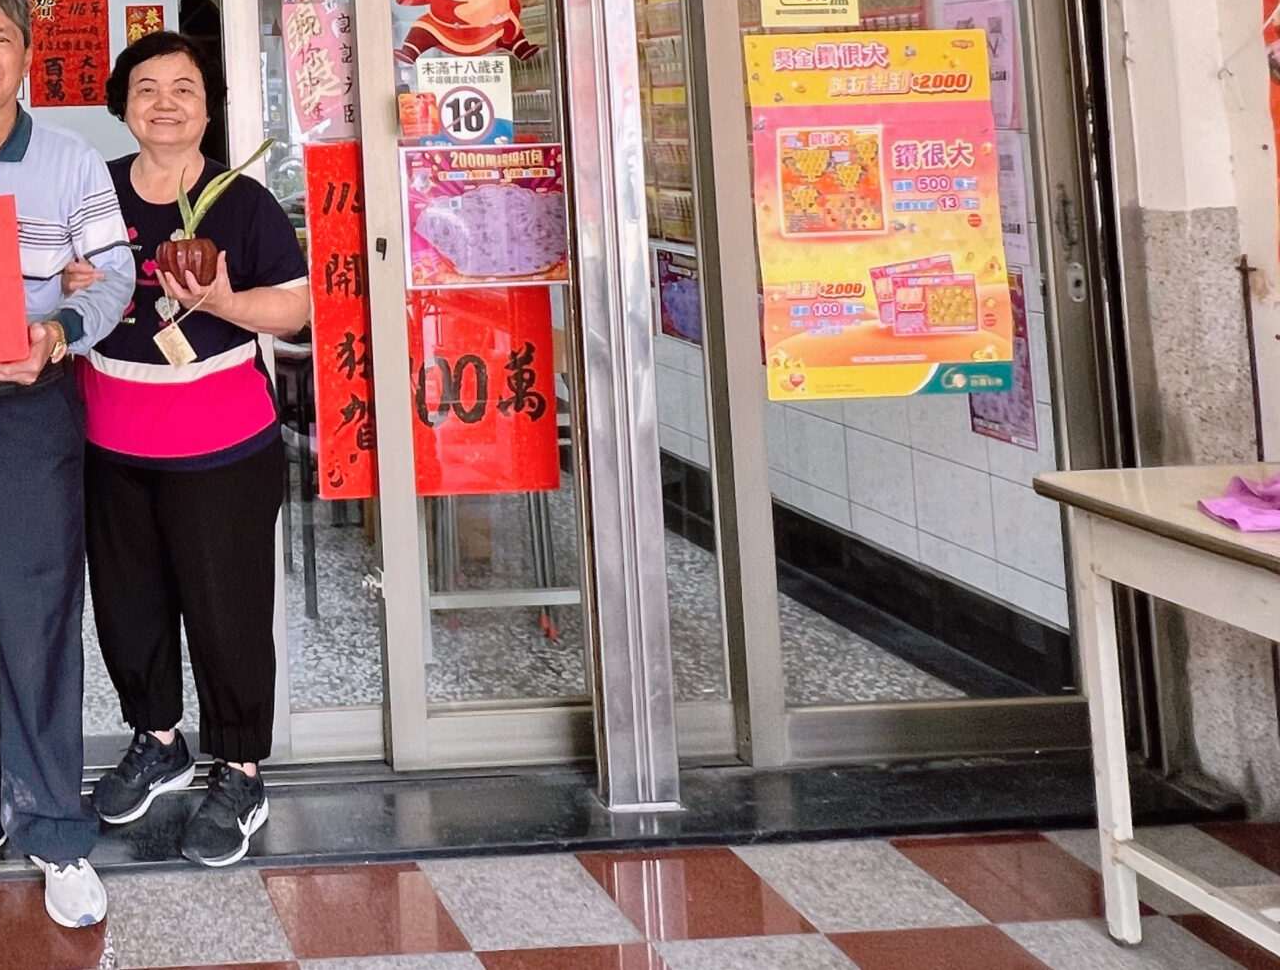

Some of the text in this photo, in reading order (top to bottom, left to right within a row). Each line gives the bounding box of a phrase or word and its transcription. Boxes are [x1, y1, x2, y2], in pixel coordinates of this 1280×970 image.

[422, 60, 504, 74] 未滿十八歲者
[446, 97, 483, 132] 18
[893, 141, 973, 168] 鑽很大
[919, 177, 949, 190] 500
[940, 197, 957, 209] 13
[813, 302, 840, 316] 100
